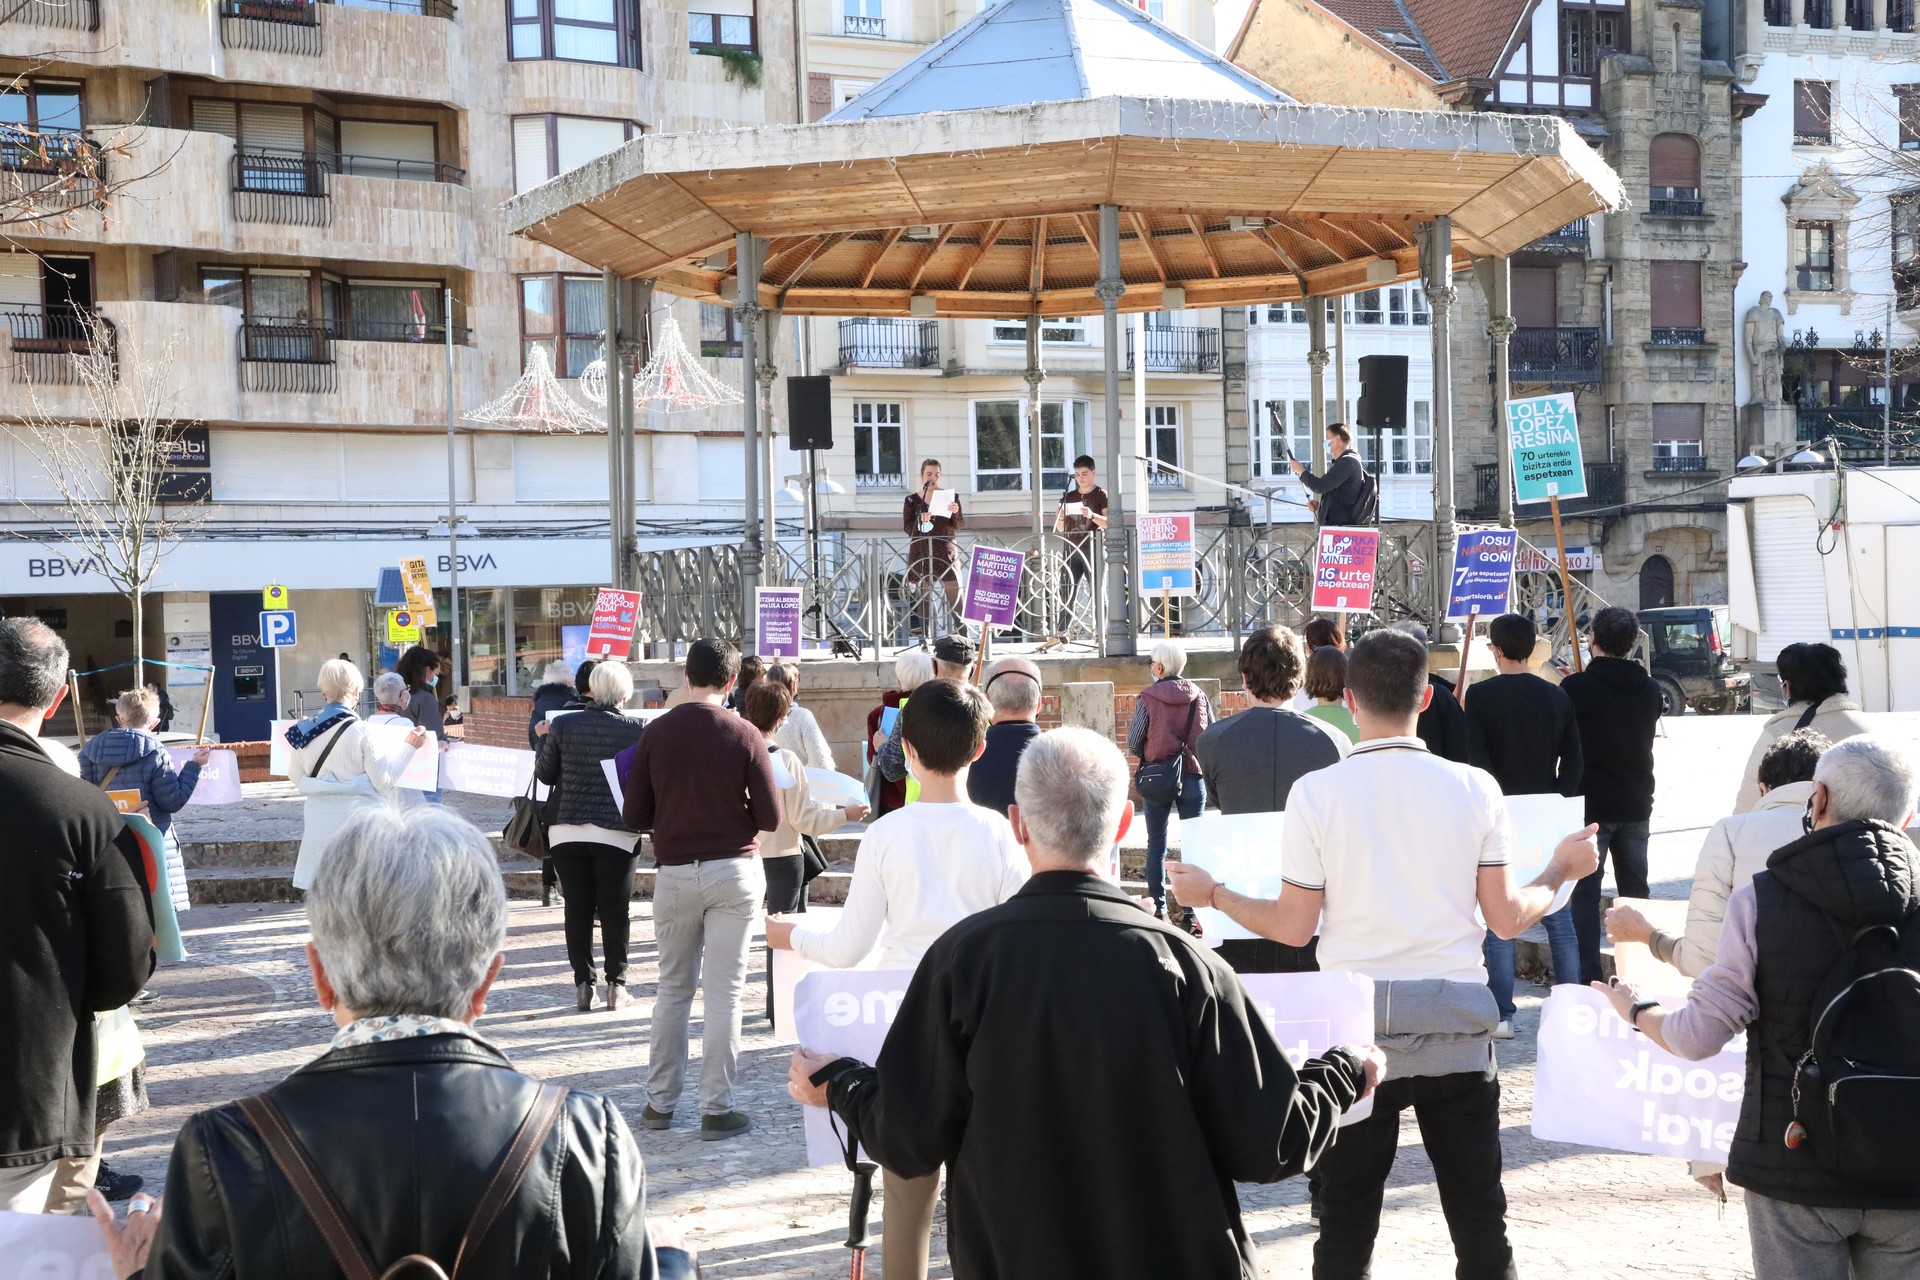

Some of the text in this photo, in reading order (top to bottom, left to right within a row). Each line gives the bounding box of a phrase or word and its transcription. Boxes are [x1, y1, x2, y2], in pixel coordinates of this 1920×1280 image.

[1508, 401, 1554, 420] LOLA
[1510, 415, 1565, 434] LOPEZ
[1512, 429, 1575, 449] RESINA
[1521, 450, 1570, 461] 70 urterekin
[1523, 459, 1572, 471] bizitza erdia
[1524, 469, 1573, 481] espetxean
[1141, 518, 1173, 527] GILLER
[1141, 525, 1178, 534] MERINO
[1141, 533, 1175, 541] BILBAO
[1333, 535, 1374, 545] GORKA
[1480, 536, 1511, 546] JOSU
[984, 553, 1011, 563] IURDAN
[1321, 555, 1364, 565] MINTEGI
[1480, 551, 1511, 562] GOÑI
[1586, 557, 1590, 567] 2
[29, 557, 99, 577] BBVA
[438, 553, 497, 572] BBVA
[977, 560, 1016, 572] MARTITEGI
[982, 568, 1009, 578] LIZASO
[1319, 568, 1371, 581] 16 urte
[1455, 567, 1469, 586] 7
[1318, 580, 1370, 589] espetxean
[598, 592, 625, 601] GORKA
[975, 589, 1010, 600] BIZI OSOKO
[597, 598, 634, 608] PALACIOS
[595, 615, 618, 623] etxetik
[266, 614, 290, 646] P
[232, 634, 261, 646] BBV
